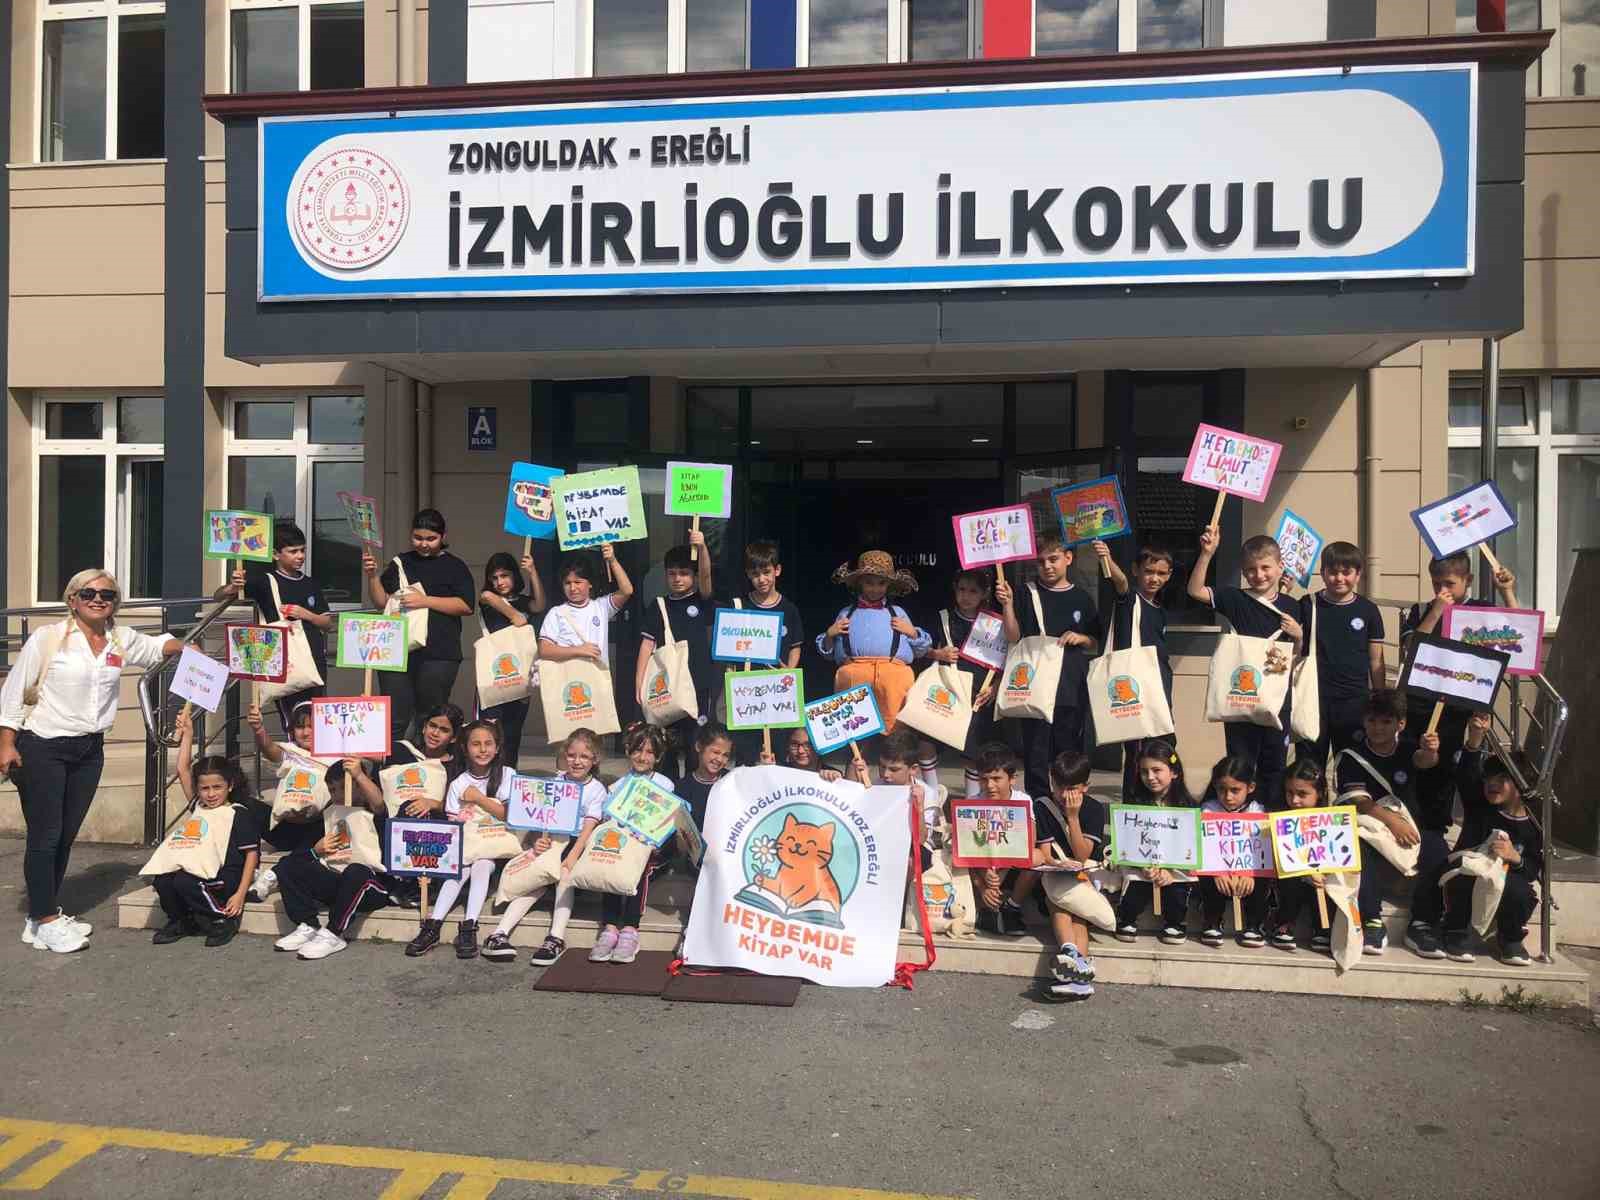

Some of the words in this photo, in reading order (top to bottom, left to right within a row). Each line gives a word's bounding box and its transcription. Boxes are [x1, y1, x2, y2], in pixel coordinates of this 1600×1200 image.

[448, 137, 617, 173] ZONGULDAK
[651, 124, 751, 167] EREĞLİ
[448, 181, 904, 270] İZMİRLİOĞLU
[936, 173, 1364, 258] İLKOKULU
[473, 415, 492, 434] A
[784, 784, 851, 814] İLKOKULU
[722, 903, 857, 957] HEYBEMDE
[738, 933, 793, 960] KİTAP
[798, 948, 833, 971] VAR
